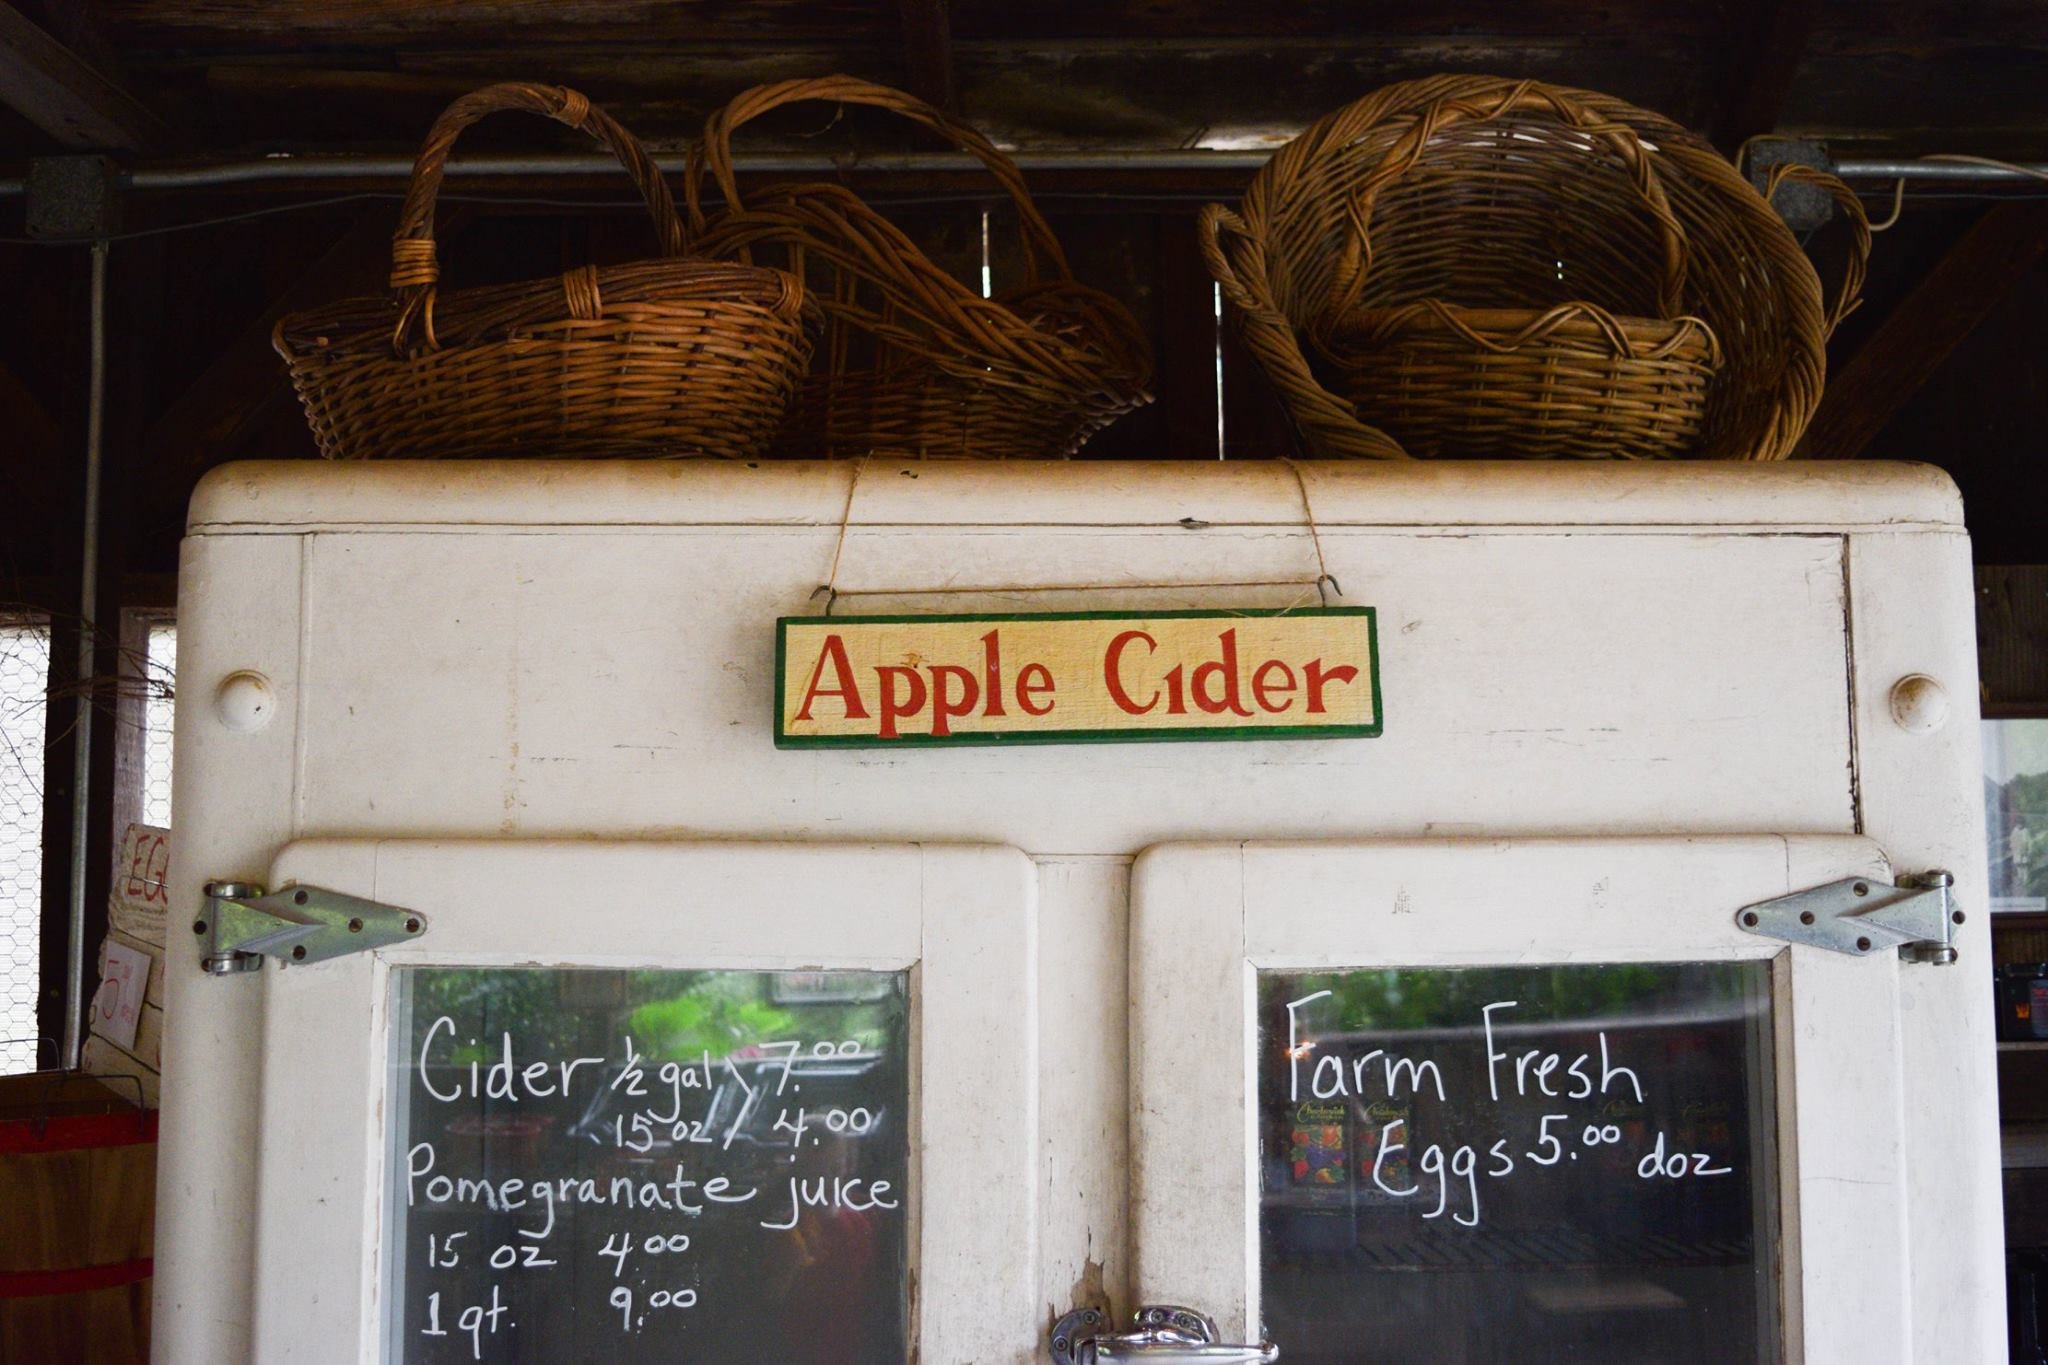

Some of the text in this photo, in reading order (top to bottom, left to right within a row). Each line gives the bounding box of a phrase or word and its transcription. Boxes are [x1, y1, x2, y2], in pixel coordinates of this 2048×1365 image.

[794, 628, 1360, 738] Apple Cider
[419, 1015, 606, 1102] Cider
[647, 1049, 712, 1124] gal
[1286, 990, 1644, 1103] Farm Fresh
[617, 1111, 653, 1153] 15
[671, 1120, 713, 1144] oz
[1372, 1114, 1733, 1226] Eggs 5.00 doz
[405, 1142, 900, 1239] Pomegranate juice
[429, 1231, 468, 1268] 15
[490, 1245, 558, 1269] oz
[421, 1291, 447, 1336] 1
